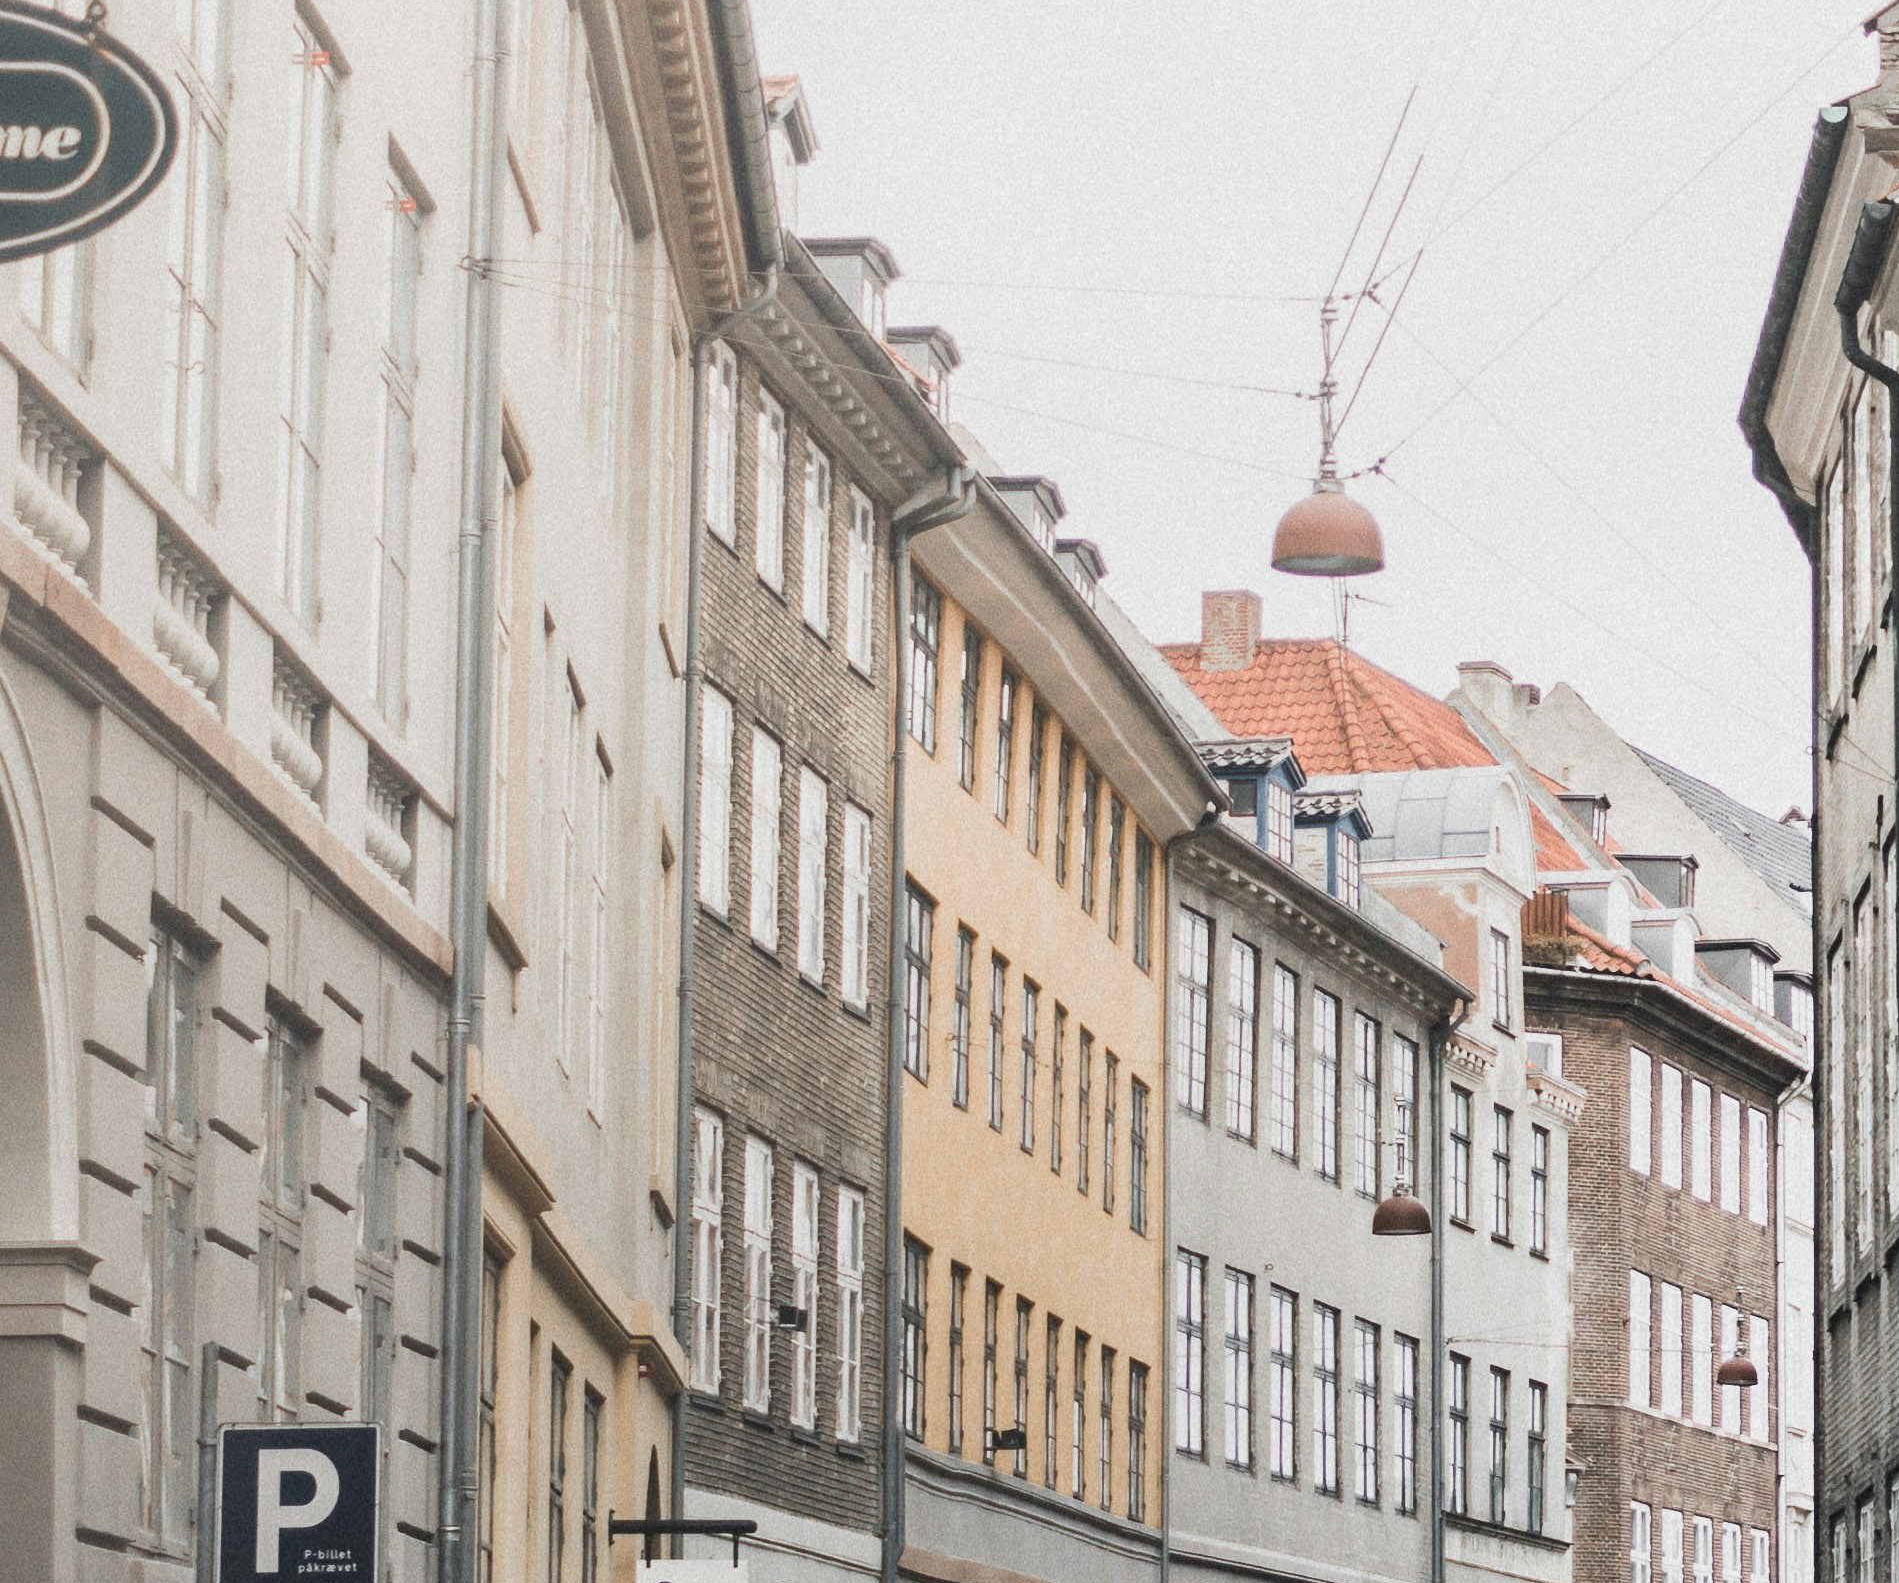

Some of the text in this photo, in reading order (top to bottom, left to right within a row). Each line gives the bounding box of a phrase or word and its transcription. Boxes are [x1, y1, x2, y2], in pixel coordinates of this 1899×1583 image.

[256, 1448, 340, 1573] P
[304, 1549, 352, 1560] P-billet
[298, 1562, 358, 1574] påkrævet
